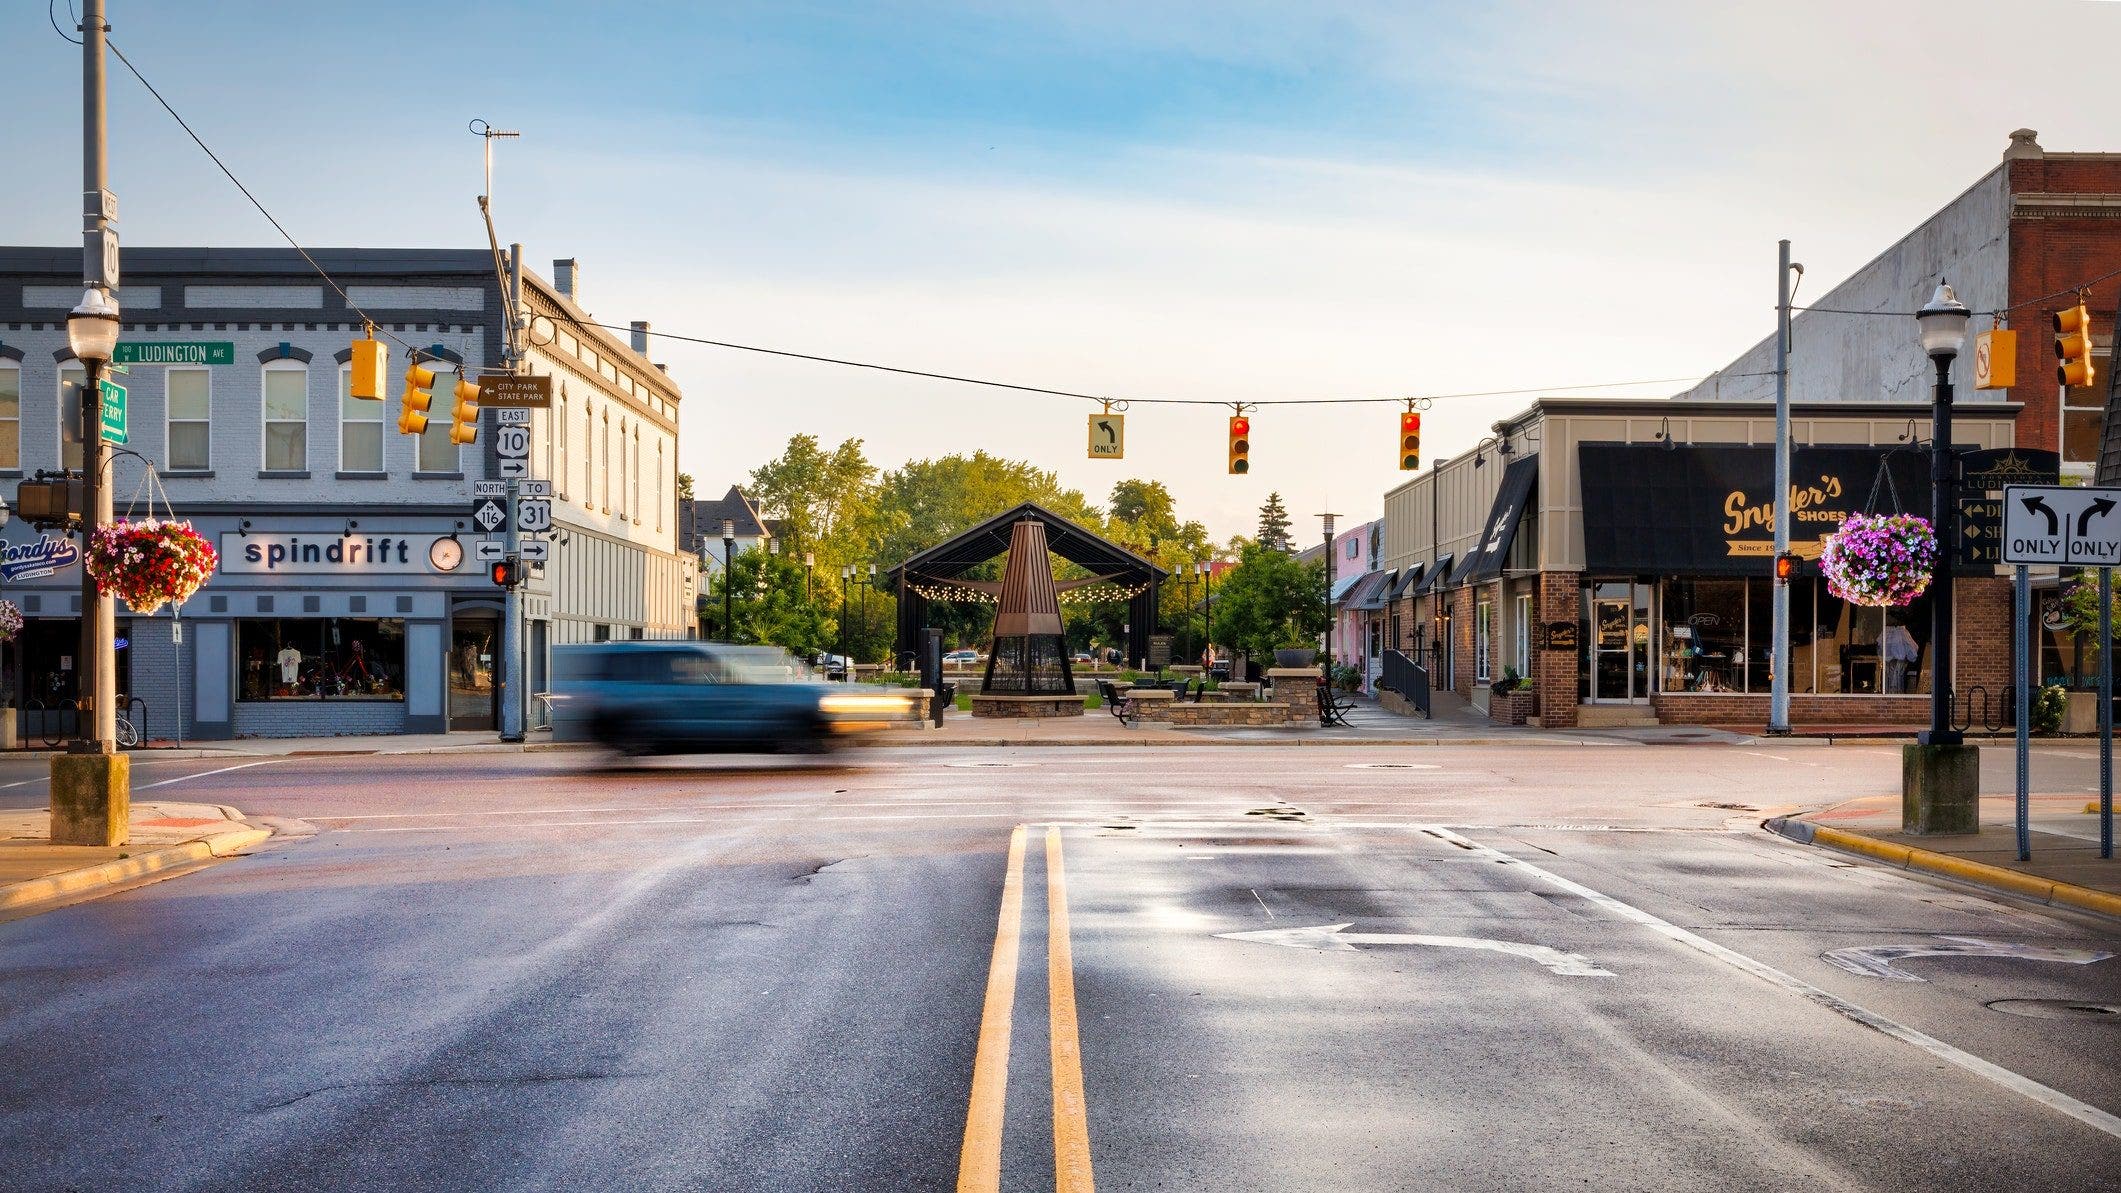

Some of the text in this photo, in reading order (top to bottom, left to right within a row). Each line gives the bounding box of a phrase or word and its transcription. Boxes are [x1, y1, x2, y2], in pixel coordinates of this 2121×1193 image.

[106, 241, 116, 274] 10
[138, 345, 225, 362] LUDINGTON AVE
[497, 383, 538, 391] CITY PARK
[105, 386, 119, 404] CAR
[523, 393, 544, 401] PARK
[103, 402, 123, 422] ERRY
[501, 410, 525, 421] EAST
[503, 432, 524, 451] 10
[1094, 445, 1118, 454] ONLY
[476, 483, 505, 493] NORTH
[527, 483, 543, 493] TO
[482, 511, 499, 524] 116
[524, 506, 544, 525] 31
[1797, 510, 1847, 522] SHOES
[1737, 544, 1762, 552] Since
[2013, 538, 2061, 554] ONLY
[2071, 540, 2119, 556] ONLY
[244, 538, 409, 569] spindrift
[17, 569, 53, 579] LUDINGTON
[1690, 616, 1719, 625] OPEN
